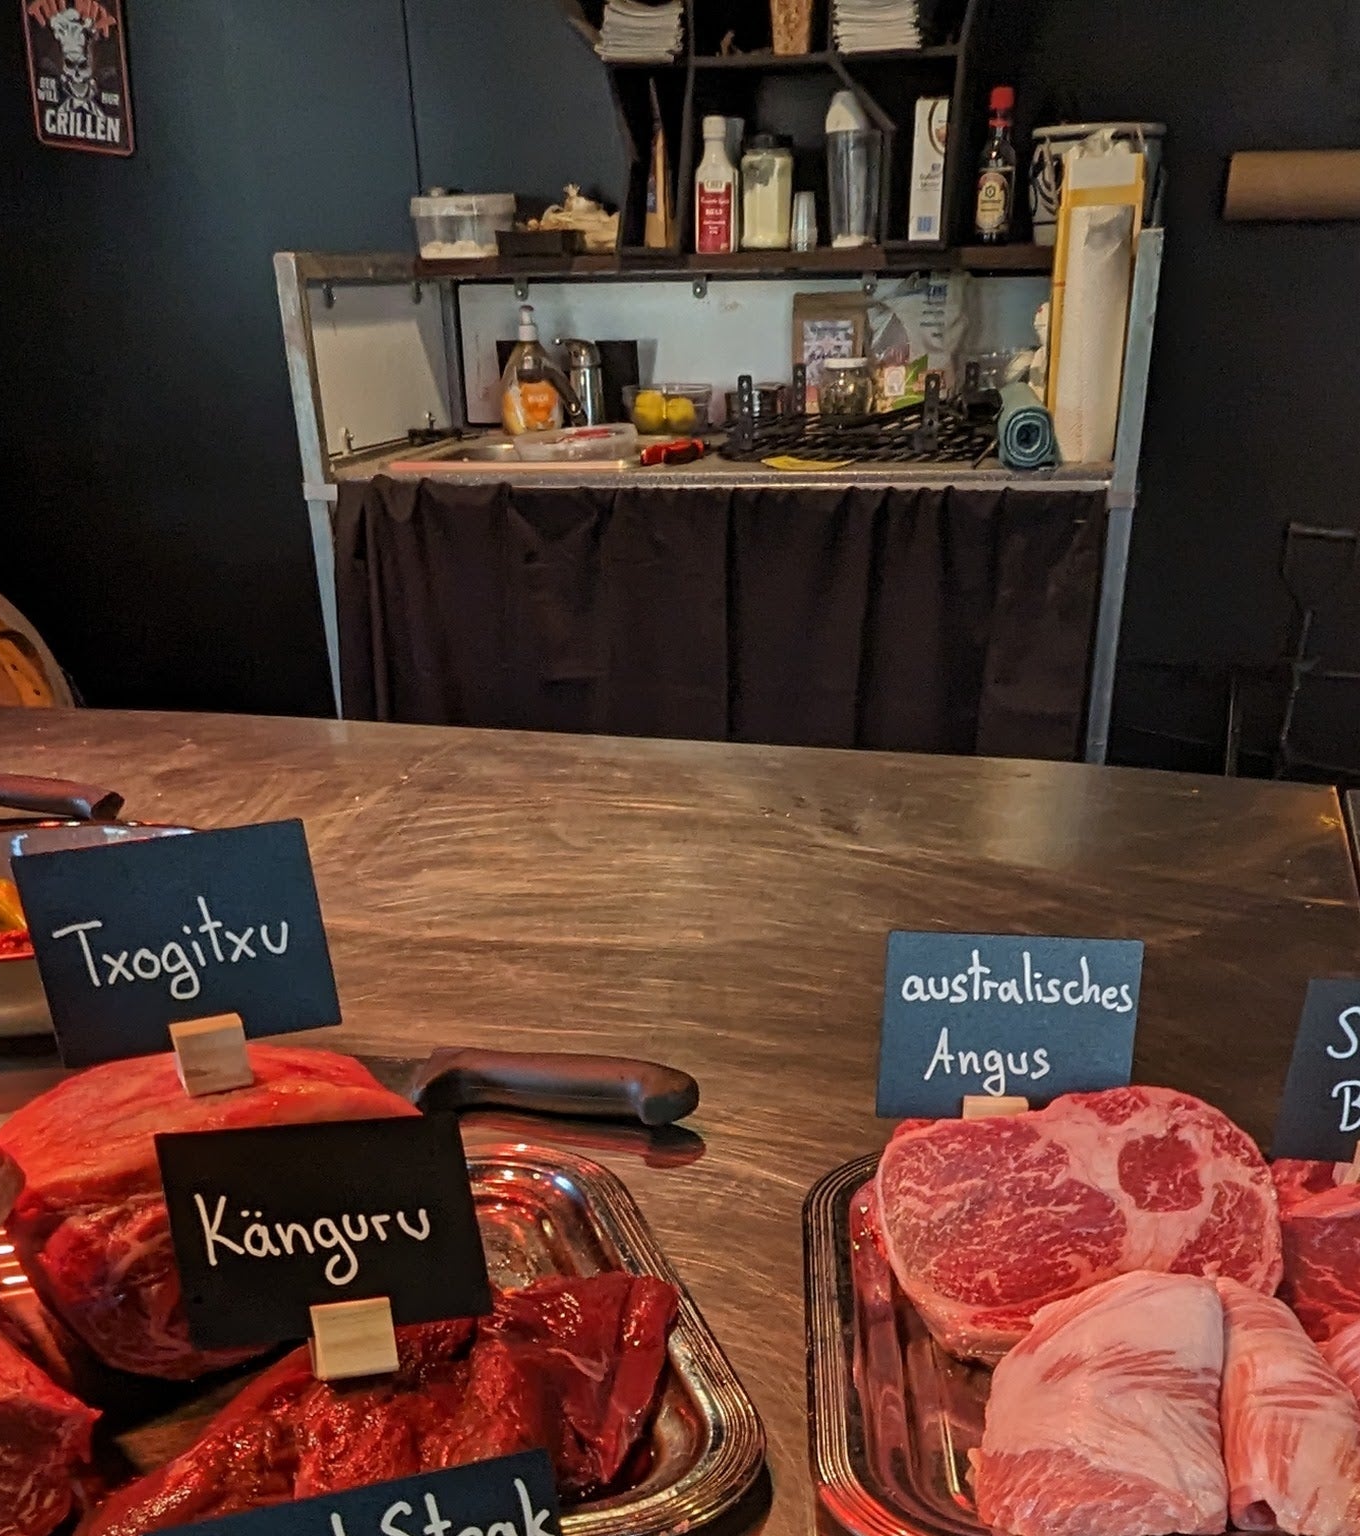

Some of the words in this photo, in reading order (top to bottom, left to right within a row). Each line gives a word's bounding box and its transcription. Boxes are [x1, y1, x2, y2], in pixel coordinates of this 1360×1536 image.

[45, 109, 120, 142] GRILLEN
[52, 895, 289, 1000] Txogitxu
[901, 949, 1133, 1013] australisches
[923, 1027, 1051, 1096] Angus
[194, 1193, 431, 1286] Känguru
